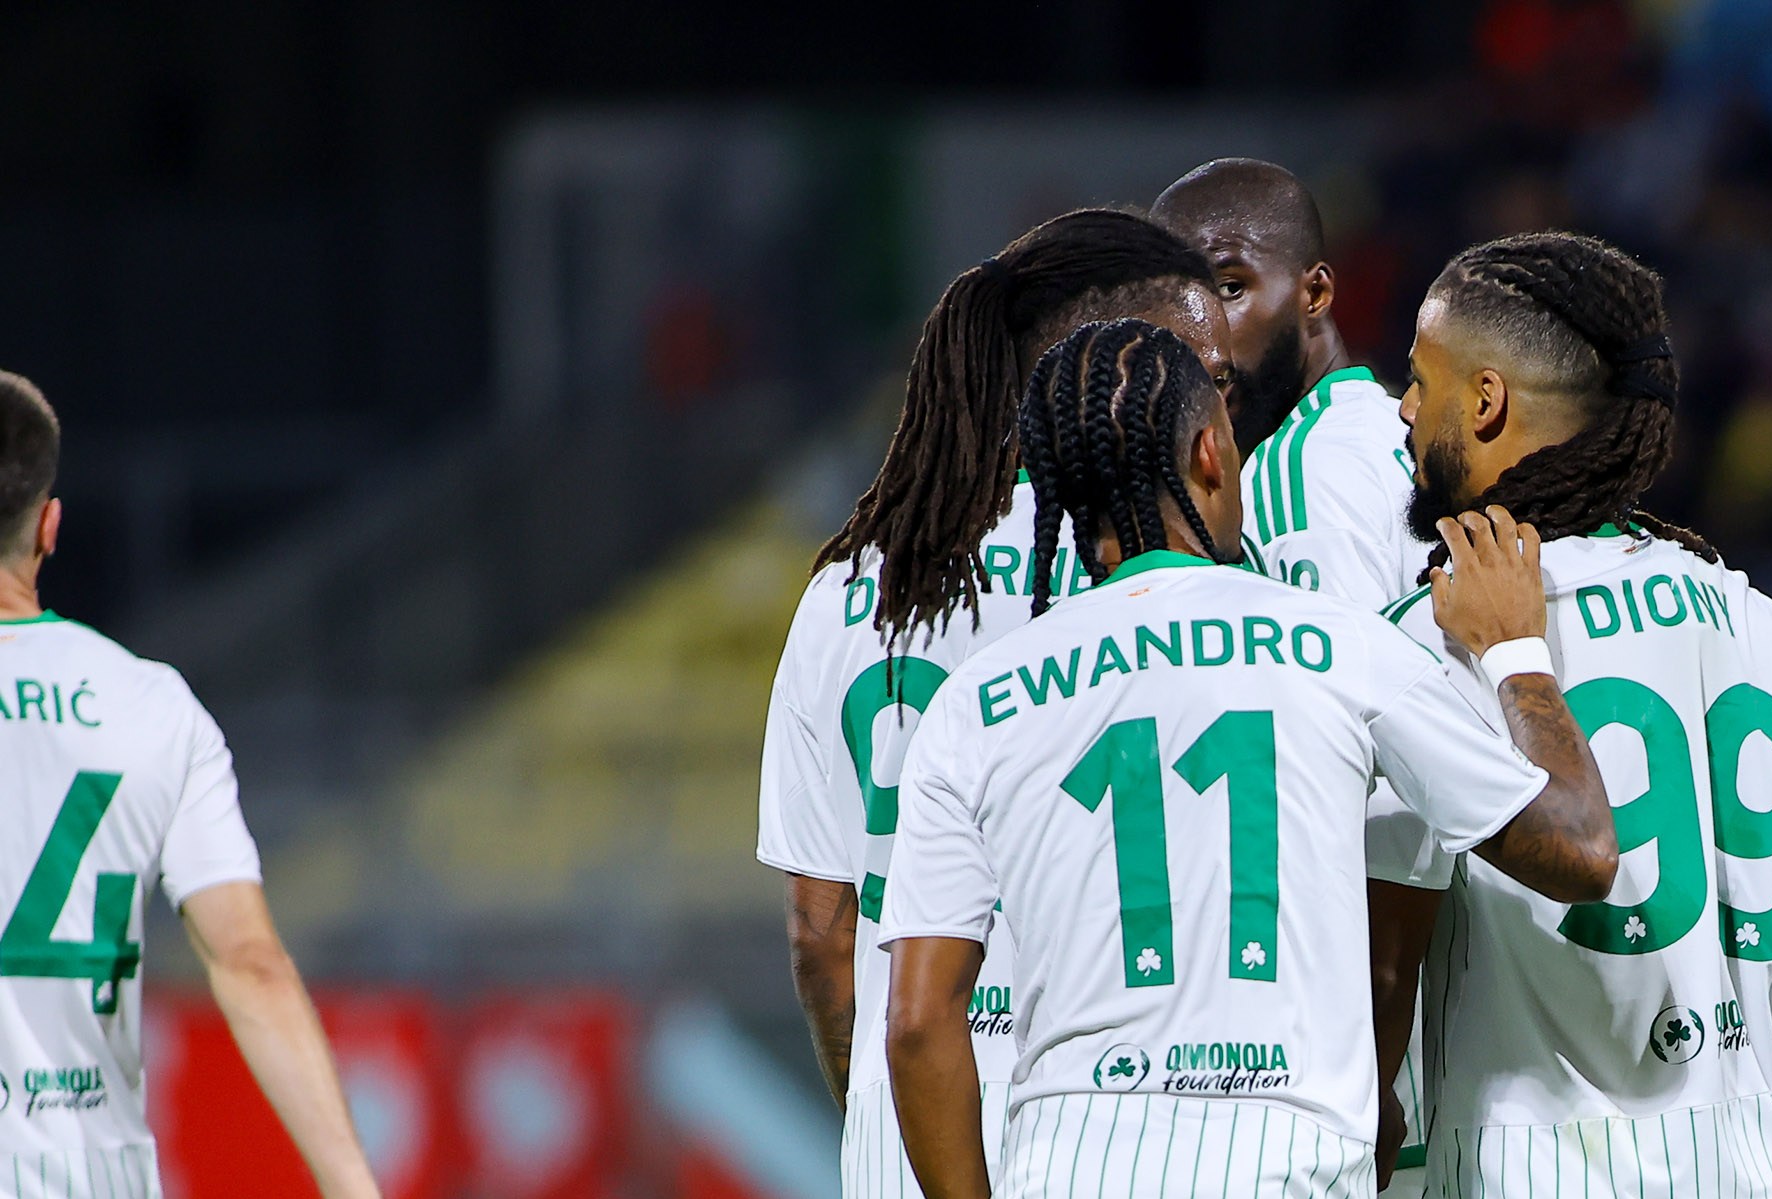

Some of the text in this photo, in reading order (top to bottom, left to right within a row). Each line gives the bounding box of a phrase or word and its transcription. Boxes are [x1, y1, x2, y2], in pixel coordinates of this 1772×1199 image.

[1576, 574, 1735, 639] DIONY
[979, 616, 1333, 727] EWANDRO
[0, 769, 140, 1015] 4
[1059, 709, 1280, 988] 11
[1162, 1063, 1290, 1095] foundation
[1166, 1042, 1289, 1071] OMONOIA
